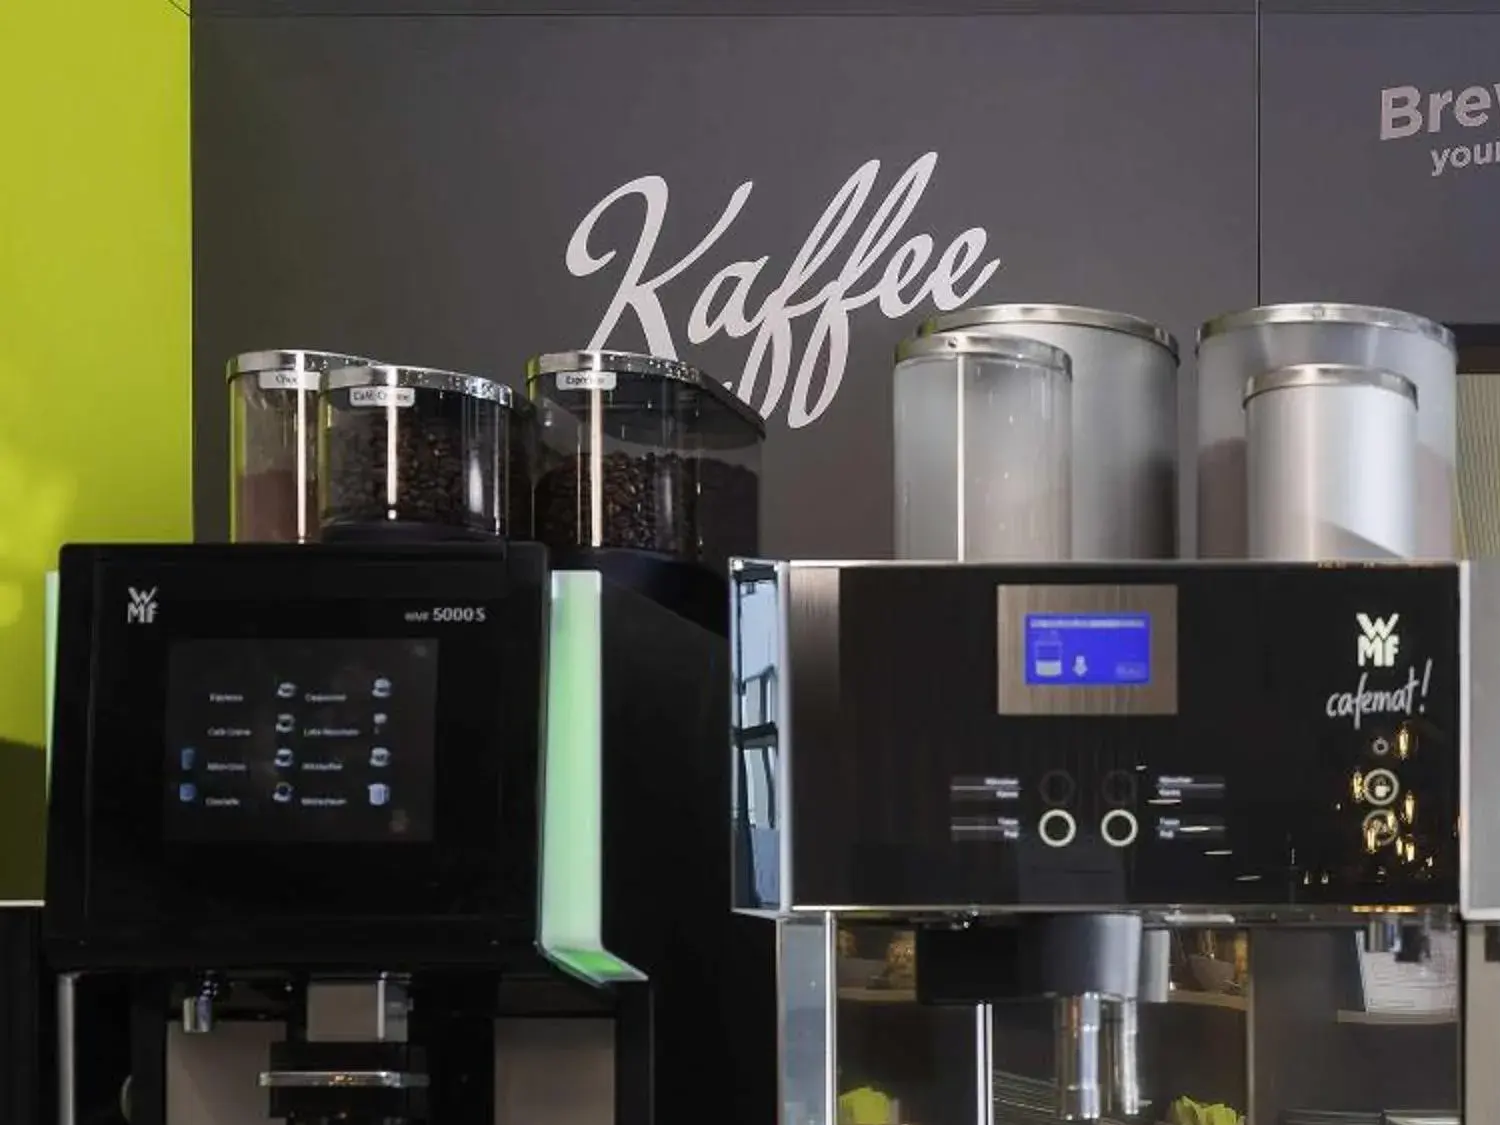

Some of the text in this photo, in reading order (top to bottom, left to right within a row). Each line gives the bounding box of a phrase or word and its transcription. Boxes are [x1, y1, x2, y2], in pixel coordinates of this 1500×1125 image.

[565, 151, 1001, 429] Kaffee
[127, 586, 160, 623] WMF
[1356, 612, 1400, 667] WMF
[1325, 657, 1433, 731] cafemat!
